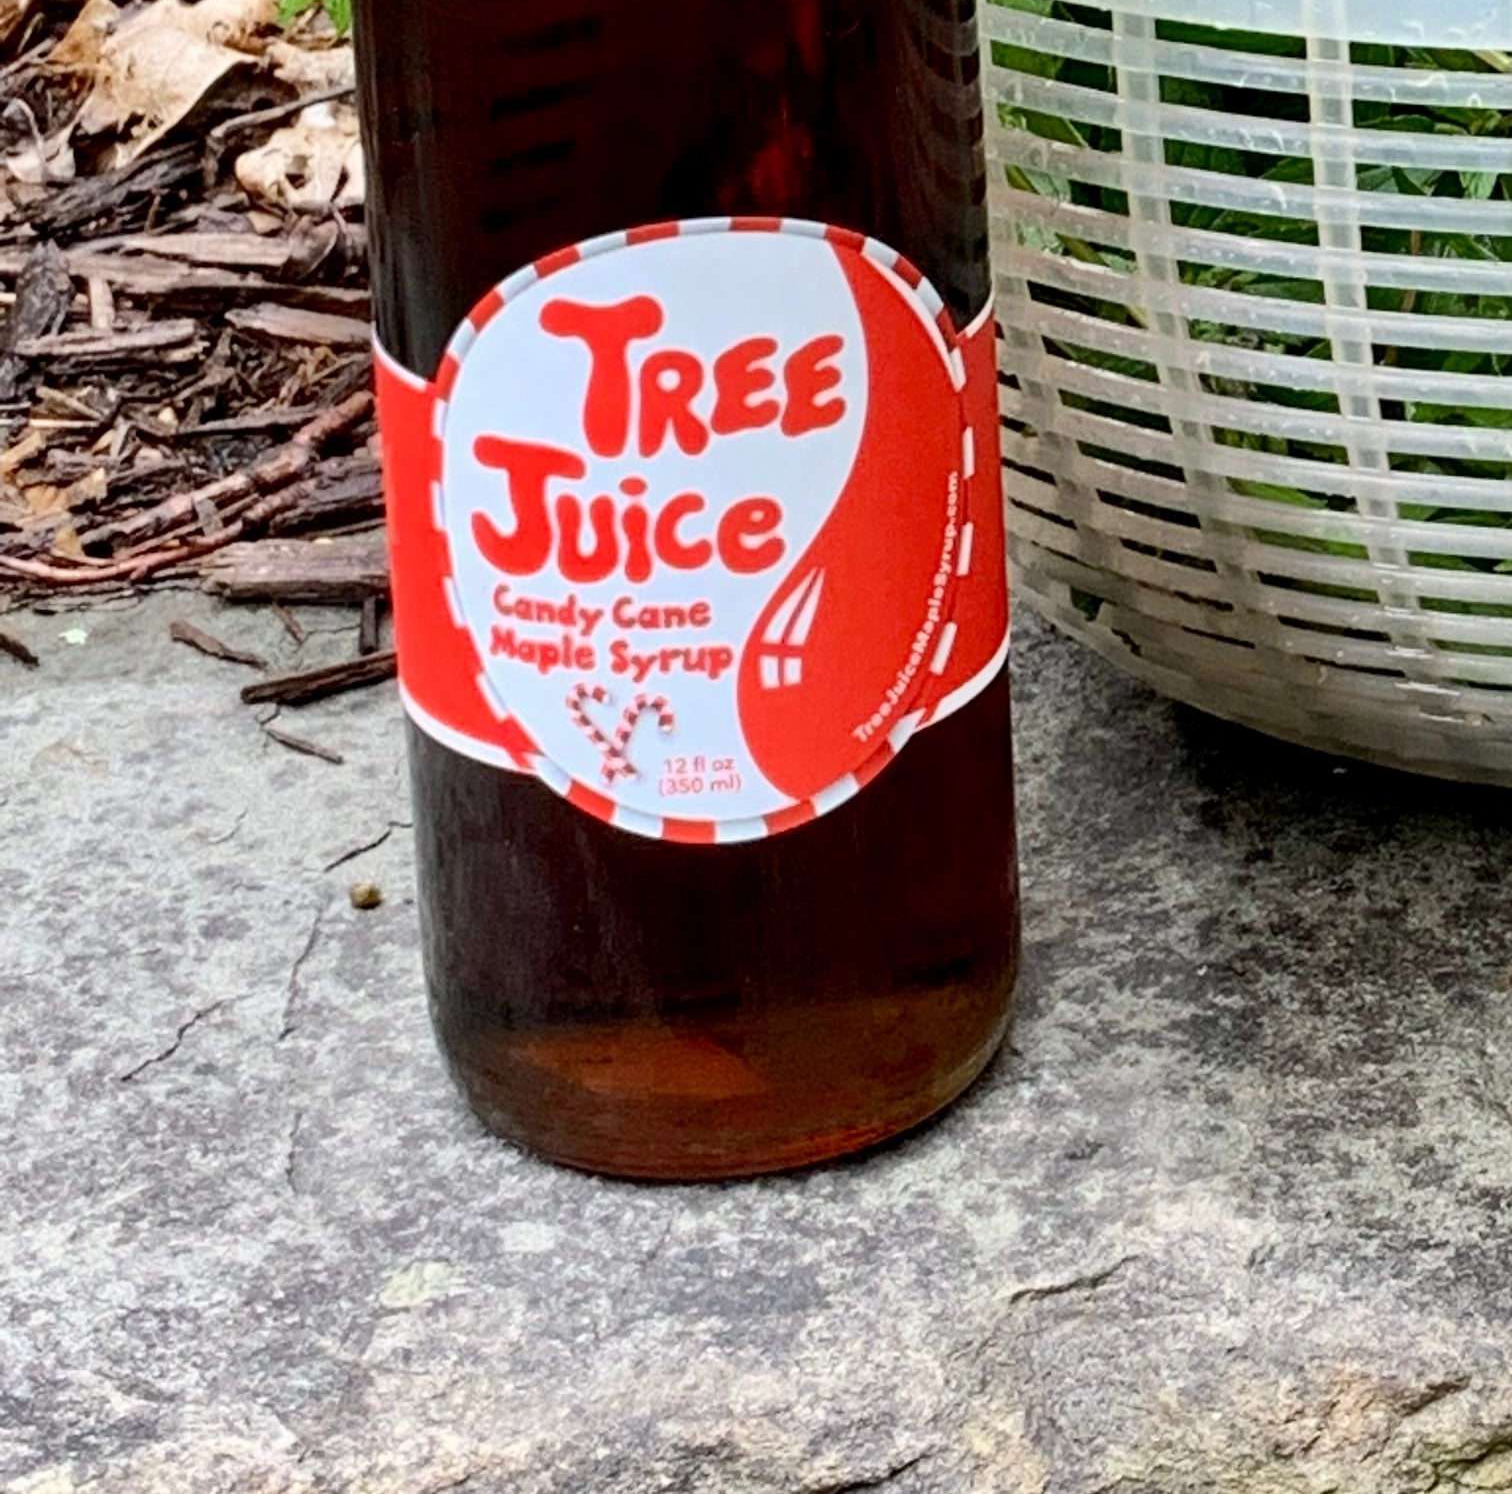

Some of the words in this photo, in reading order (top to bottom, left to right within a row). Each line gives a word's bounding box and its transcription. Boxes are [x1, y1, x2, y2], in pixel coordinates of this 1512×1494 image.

[539, 295, 846, 458] TREE
[471, 435, 786, 583] Juice
[493, 584, 604, 636] Candy
[612, 596, 712, 629] Cane
[490, 625, 596, 675] Maple
[609, 640, 734, 683] Syrup
[658, 776, 704, 797] (350
[710, 774, 742, 793] ml)
[664, 758, 688, 773] 12
[712, 758, 735, 772] oz
